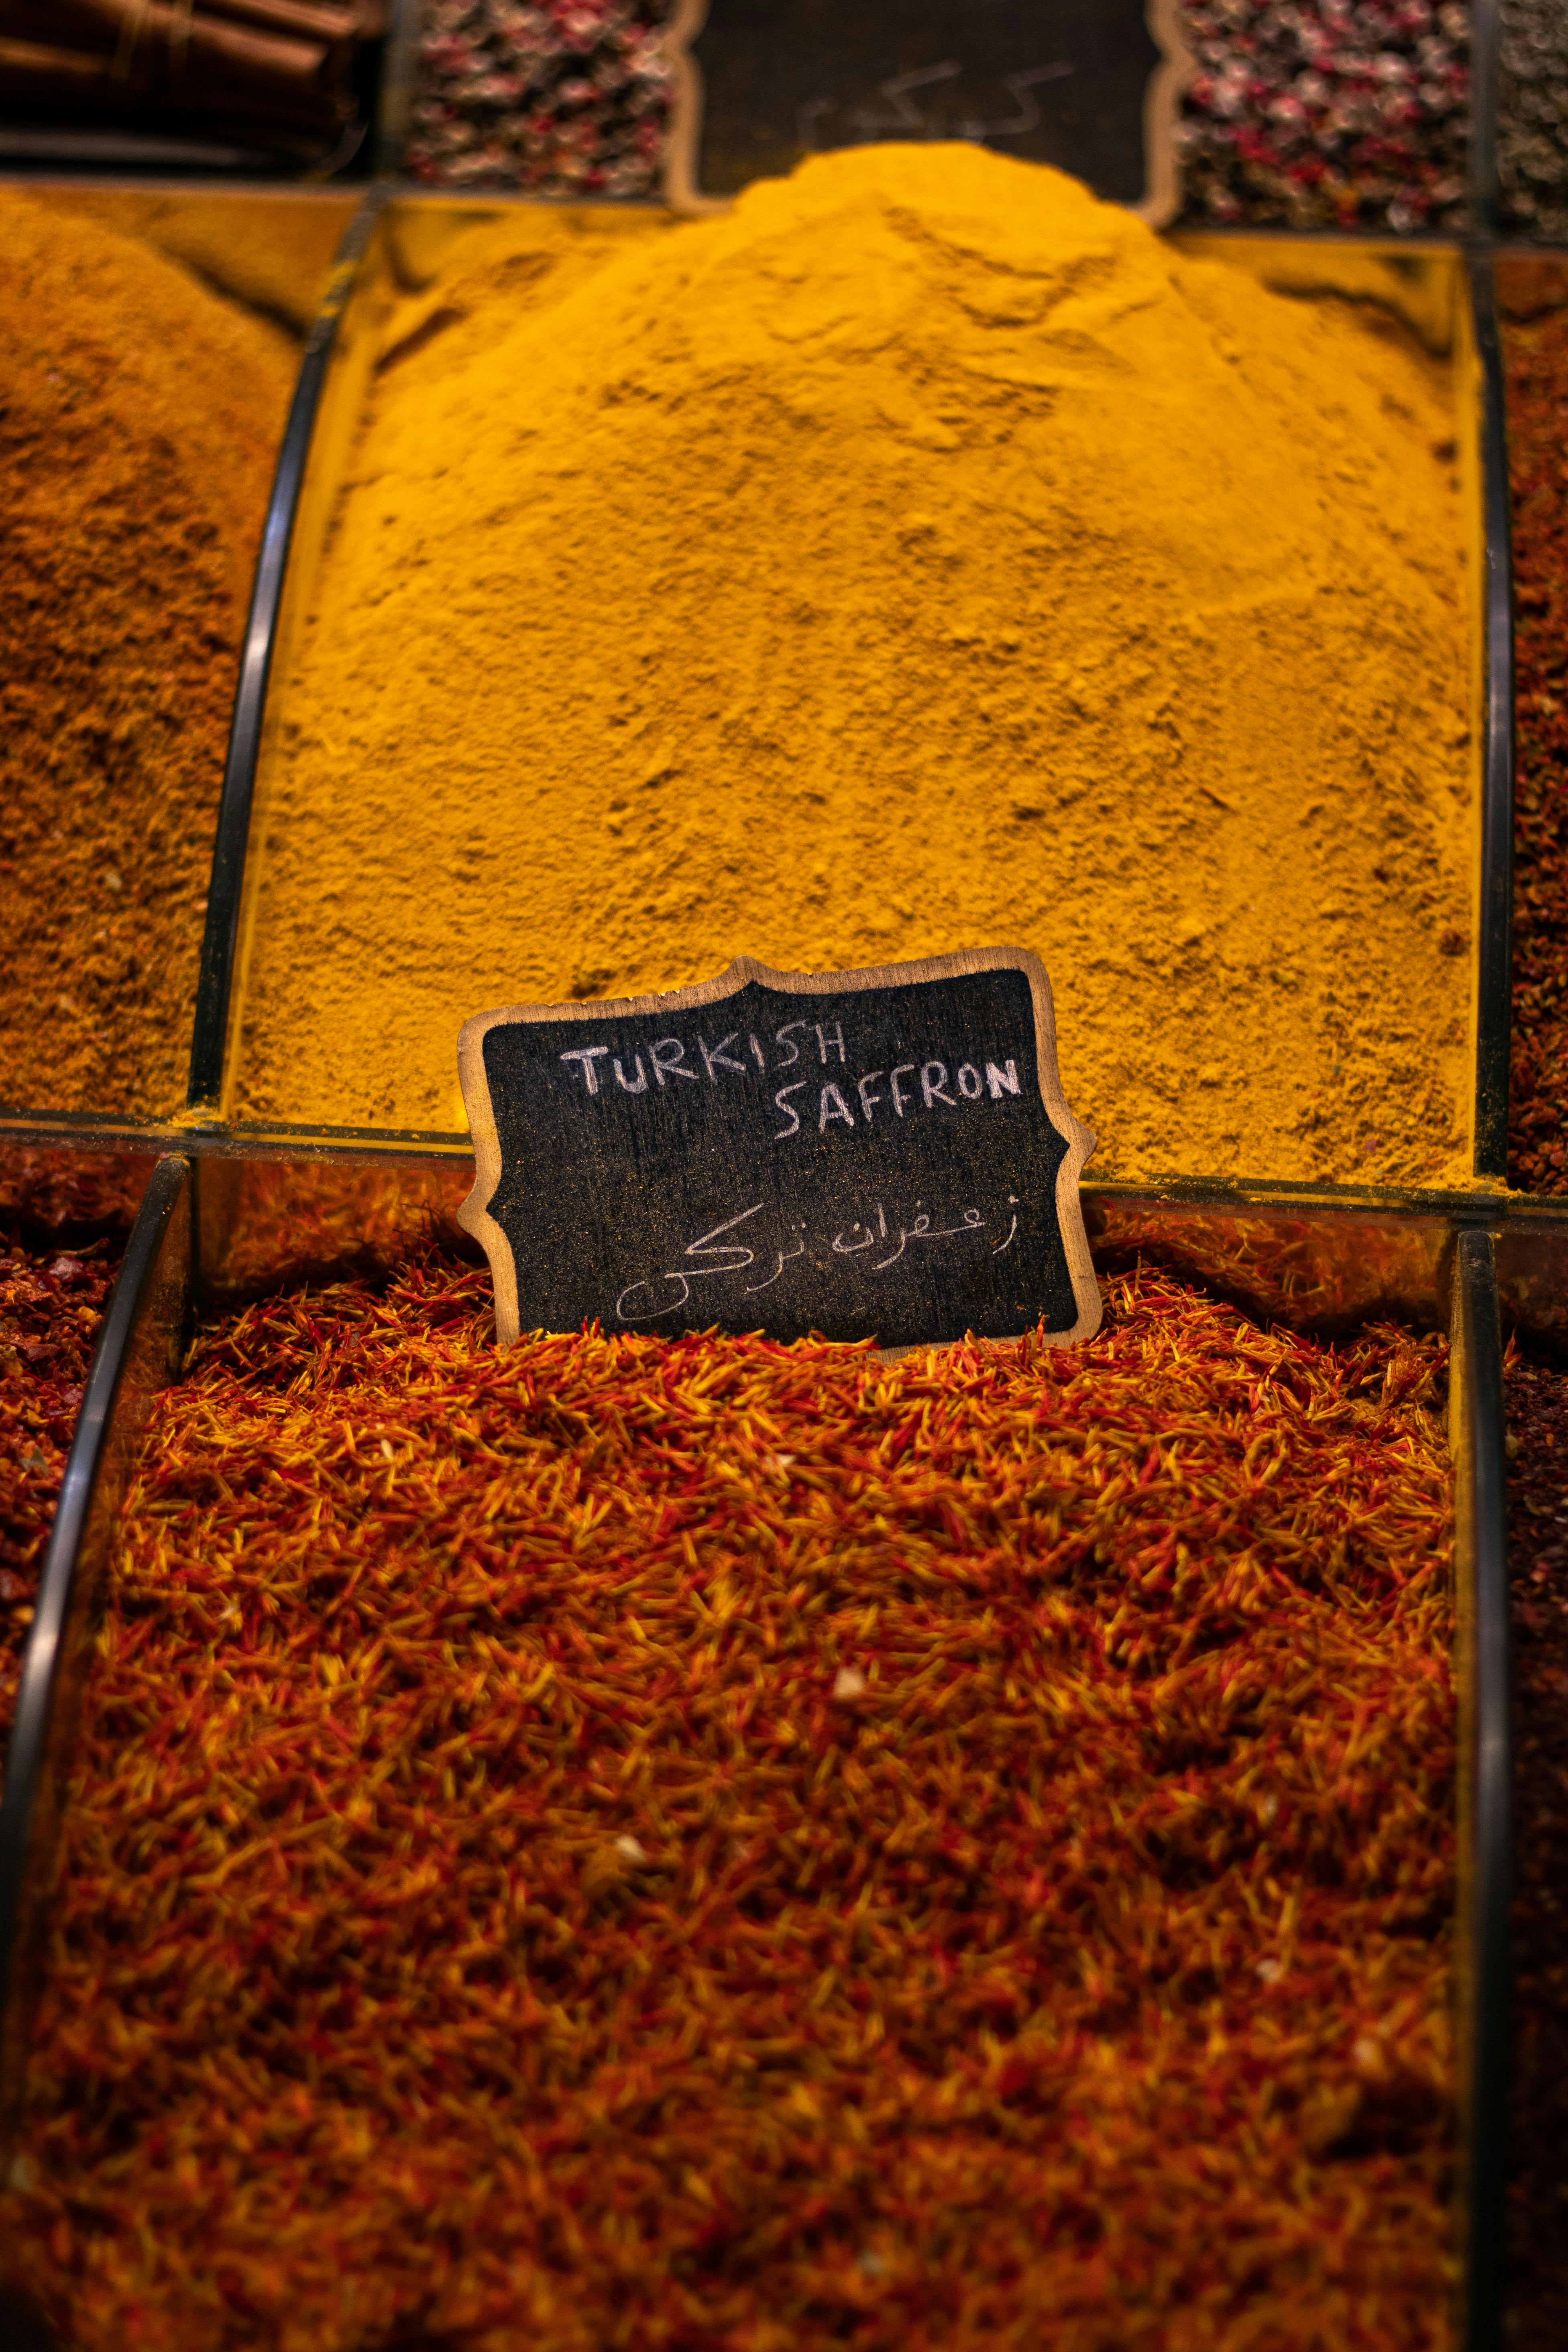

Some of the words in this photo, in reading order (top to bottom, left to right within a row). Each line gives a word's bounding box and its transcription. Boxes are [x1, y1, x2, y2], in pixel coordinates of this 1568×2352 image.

[560, 1020, 846, 1096] TURKISH
[774, 1059, 1022, 1140] SAFFRON
[832, 1195, 1019, 1270] زعفران
